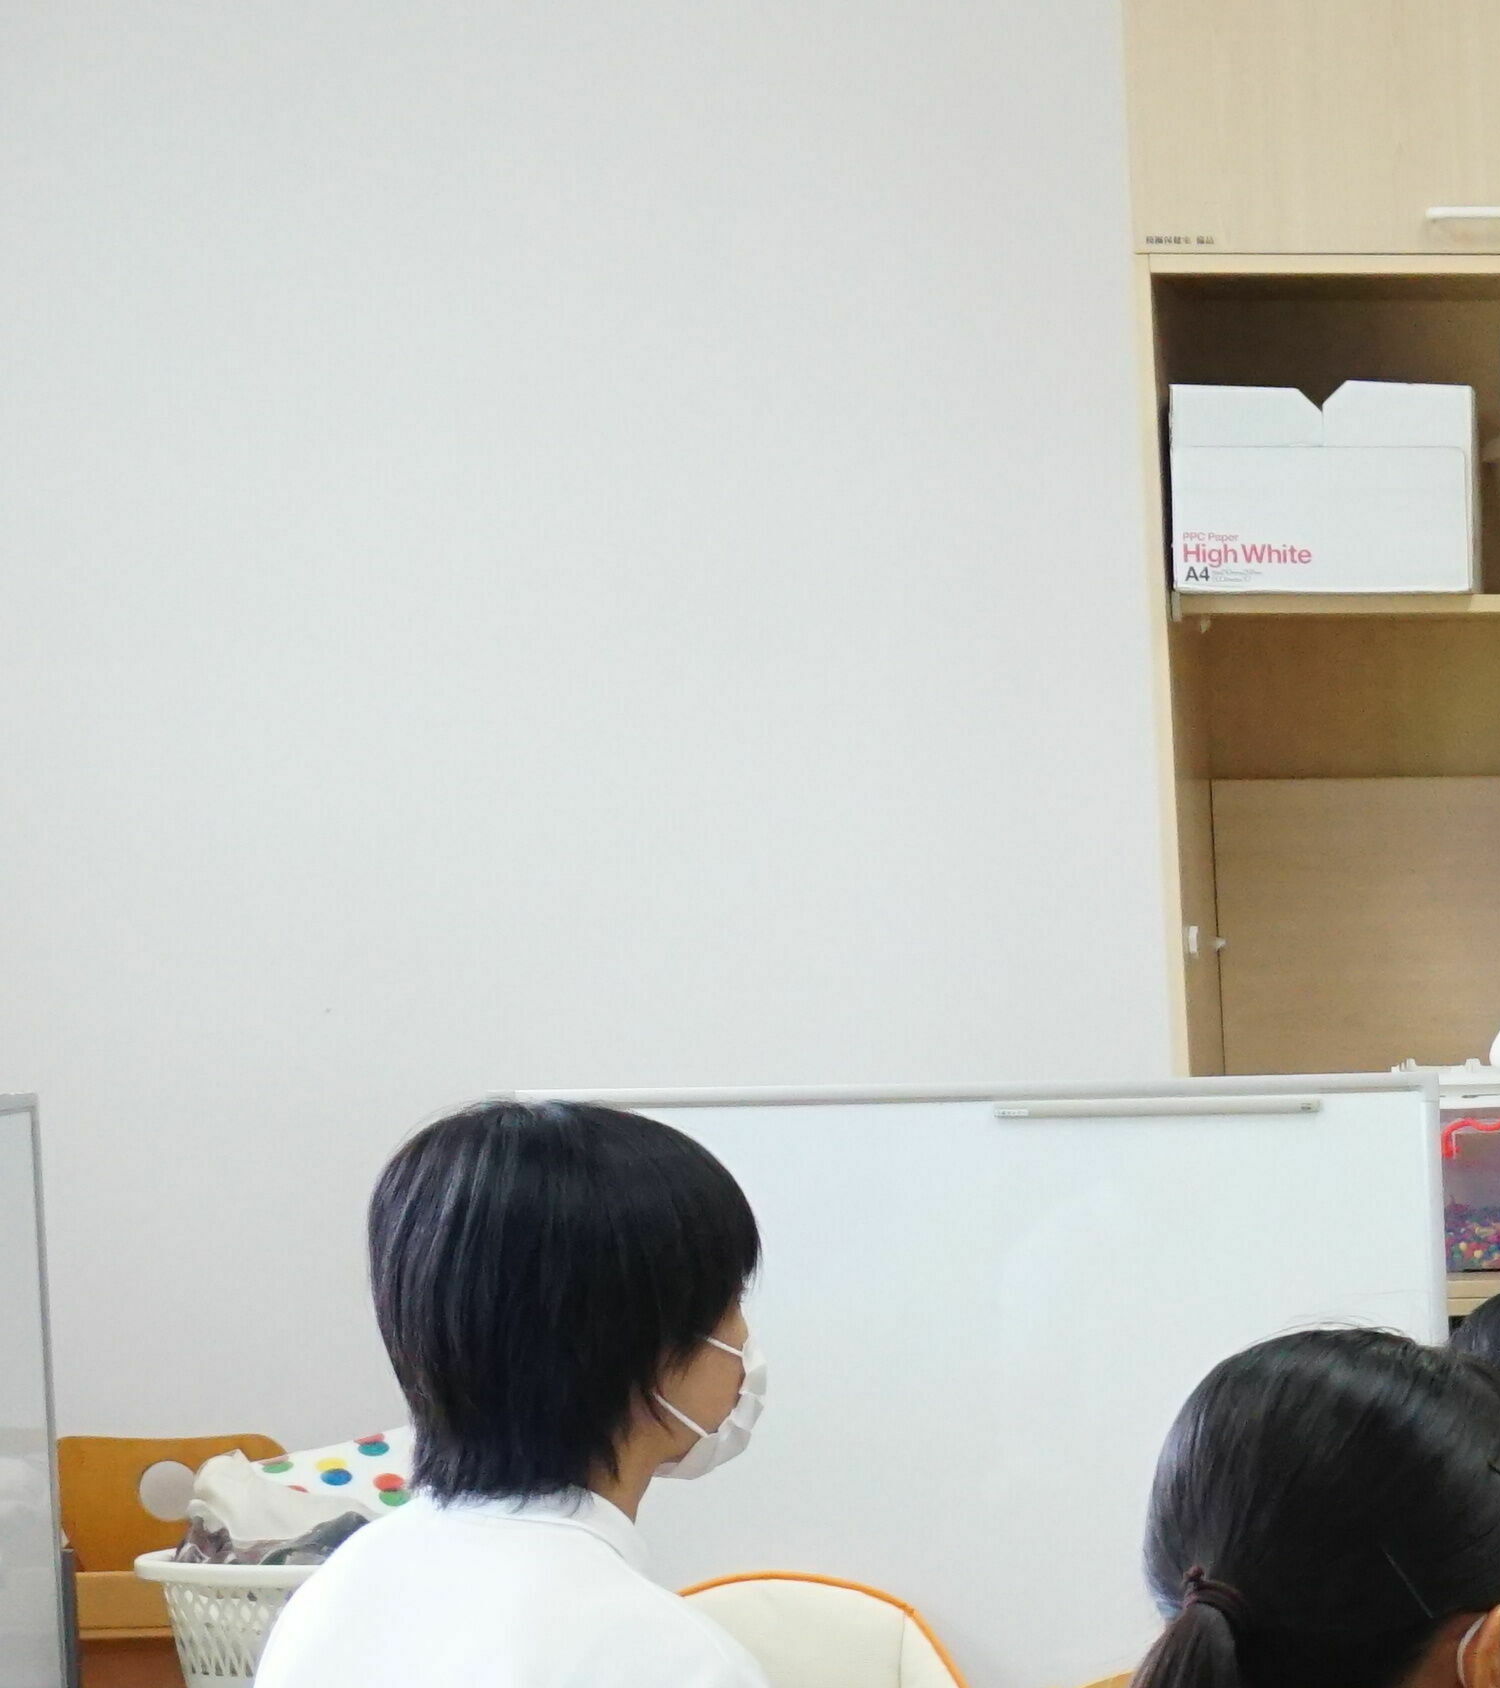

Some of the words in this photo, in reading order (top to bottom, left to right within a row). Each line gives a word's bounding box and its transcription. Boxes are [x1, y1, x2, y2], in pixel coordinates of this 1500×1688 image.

[1183, 532, 1206, 541] PPC
[1208, 532, 1239, 543] Paper
[1183, 543, 1238, 568] High
[1241, 544, 1312, 564] White
[1185, 566, 1210, 582] A4
